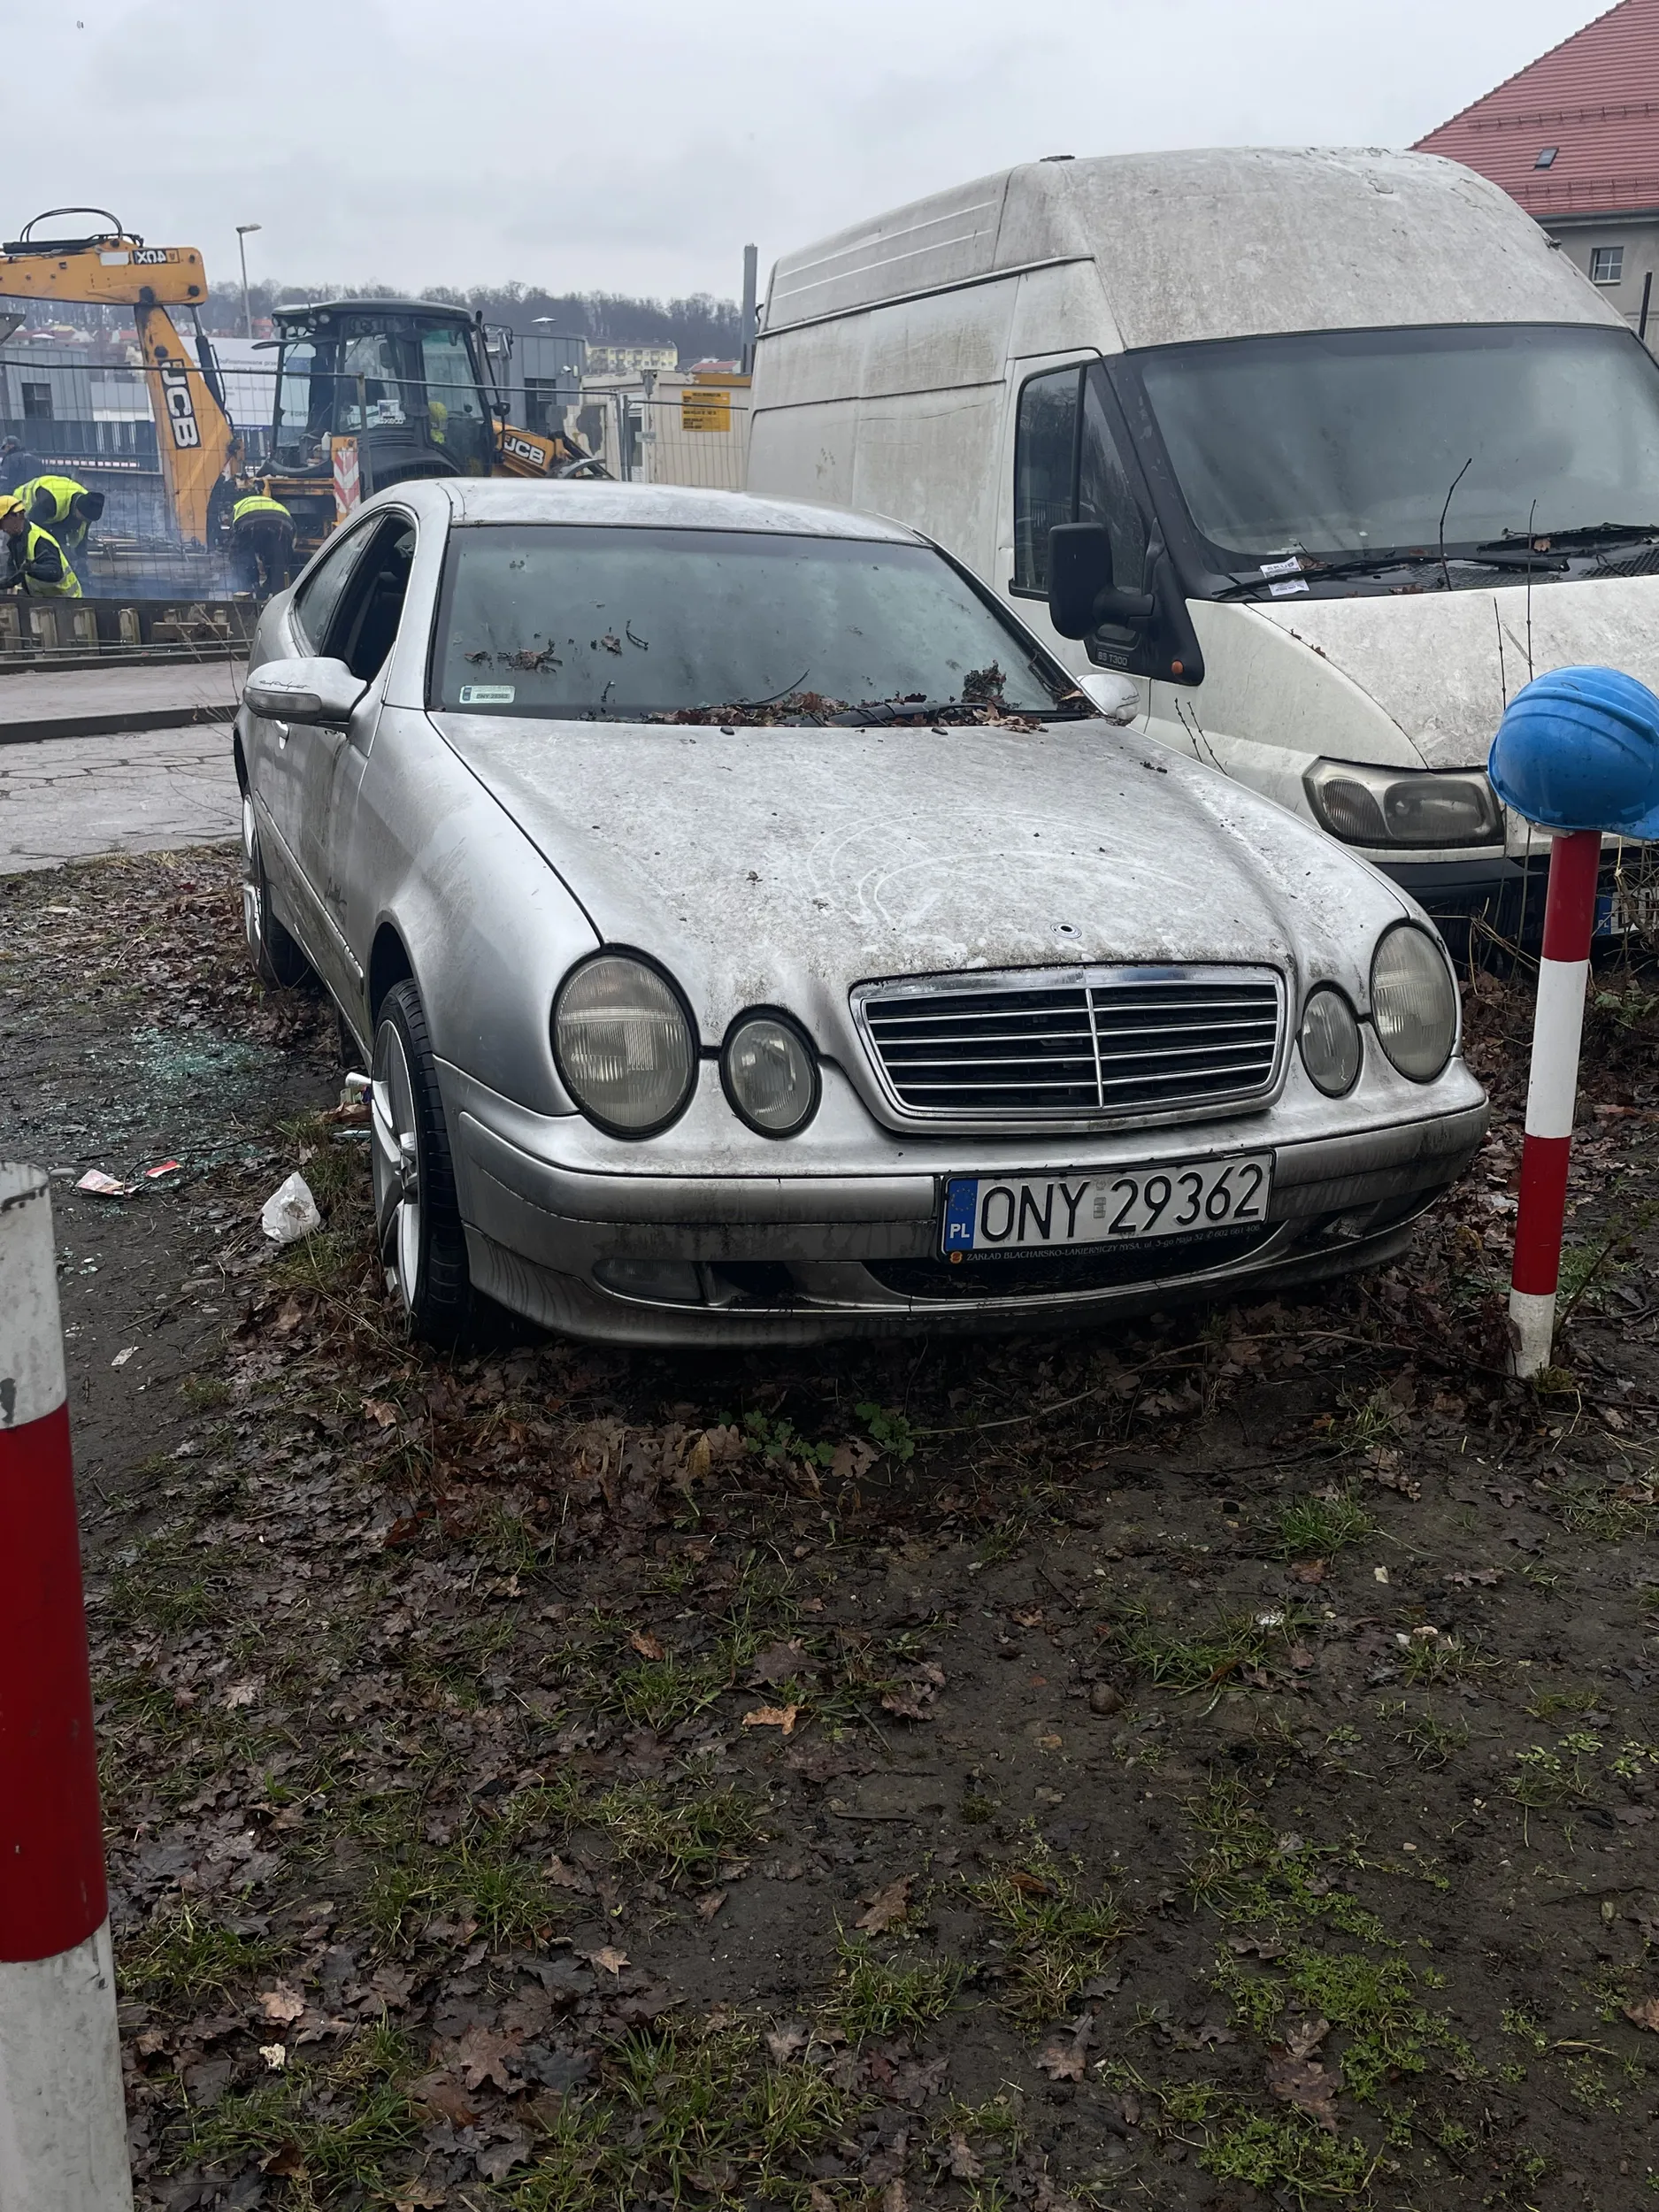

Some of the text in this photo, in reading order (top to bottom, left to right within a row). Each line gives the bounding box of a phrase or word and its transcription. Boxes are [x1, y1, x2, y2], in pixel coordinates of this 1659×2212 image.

[161, 361, 198, 447] JCB
[504, 437, 544, 465] JCB
[1109, 654, 1128, 666] T300
[949, 1164, 1263, 1242] PL ONY 29362
[966, 1251, 1002, 1262] ZAKŁAD
